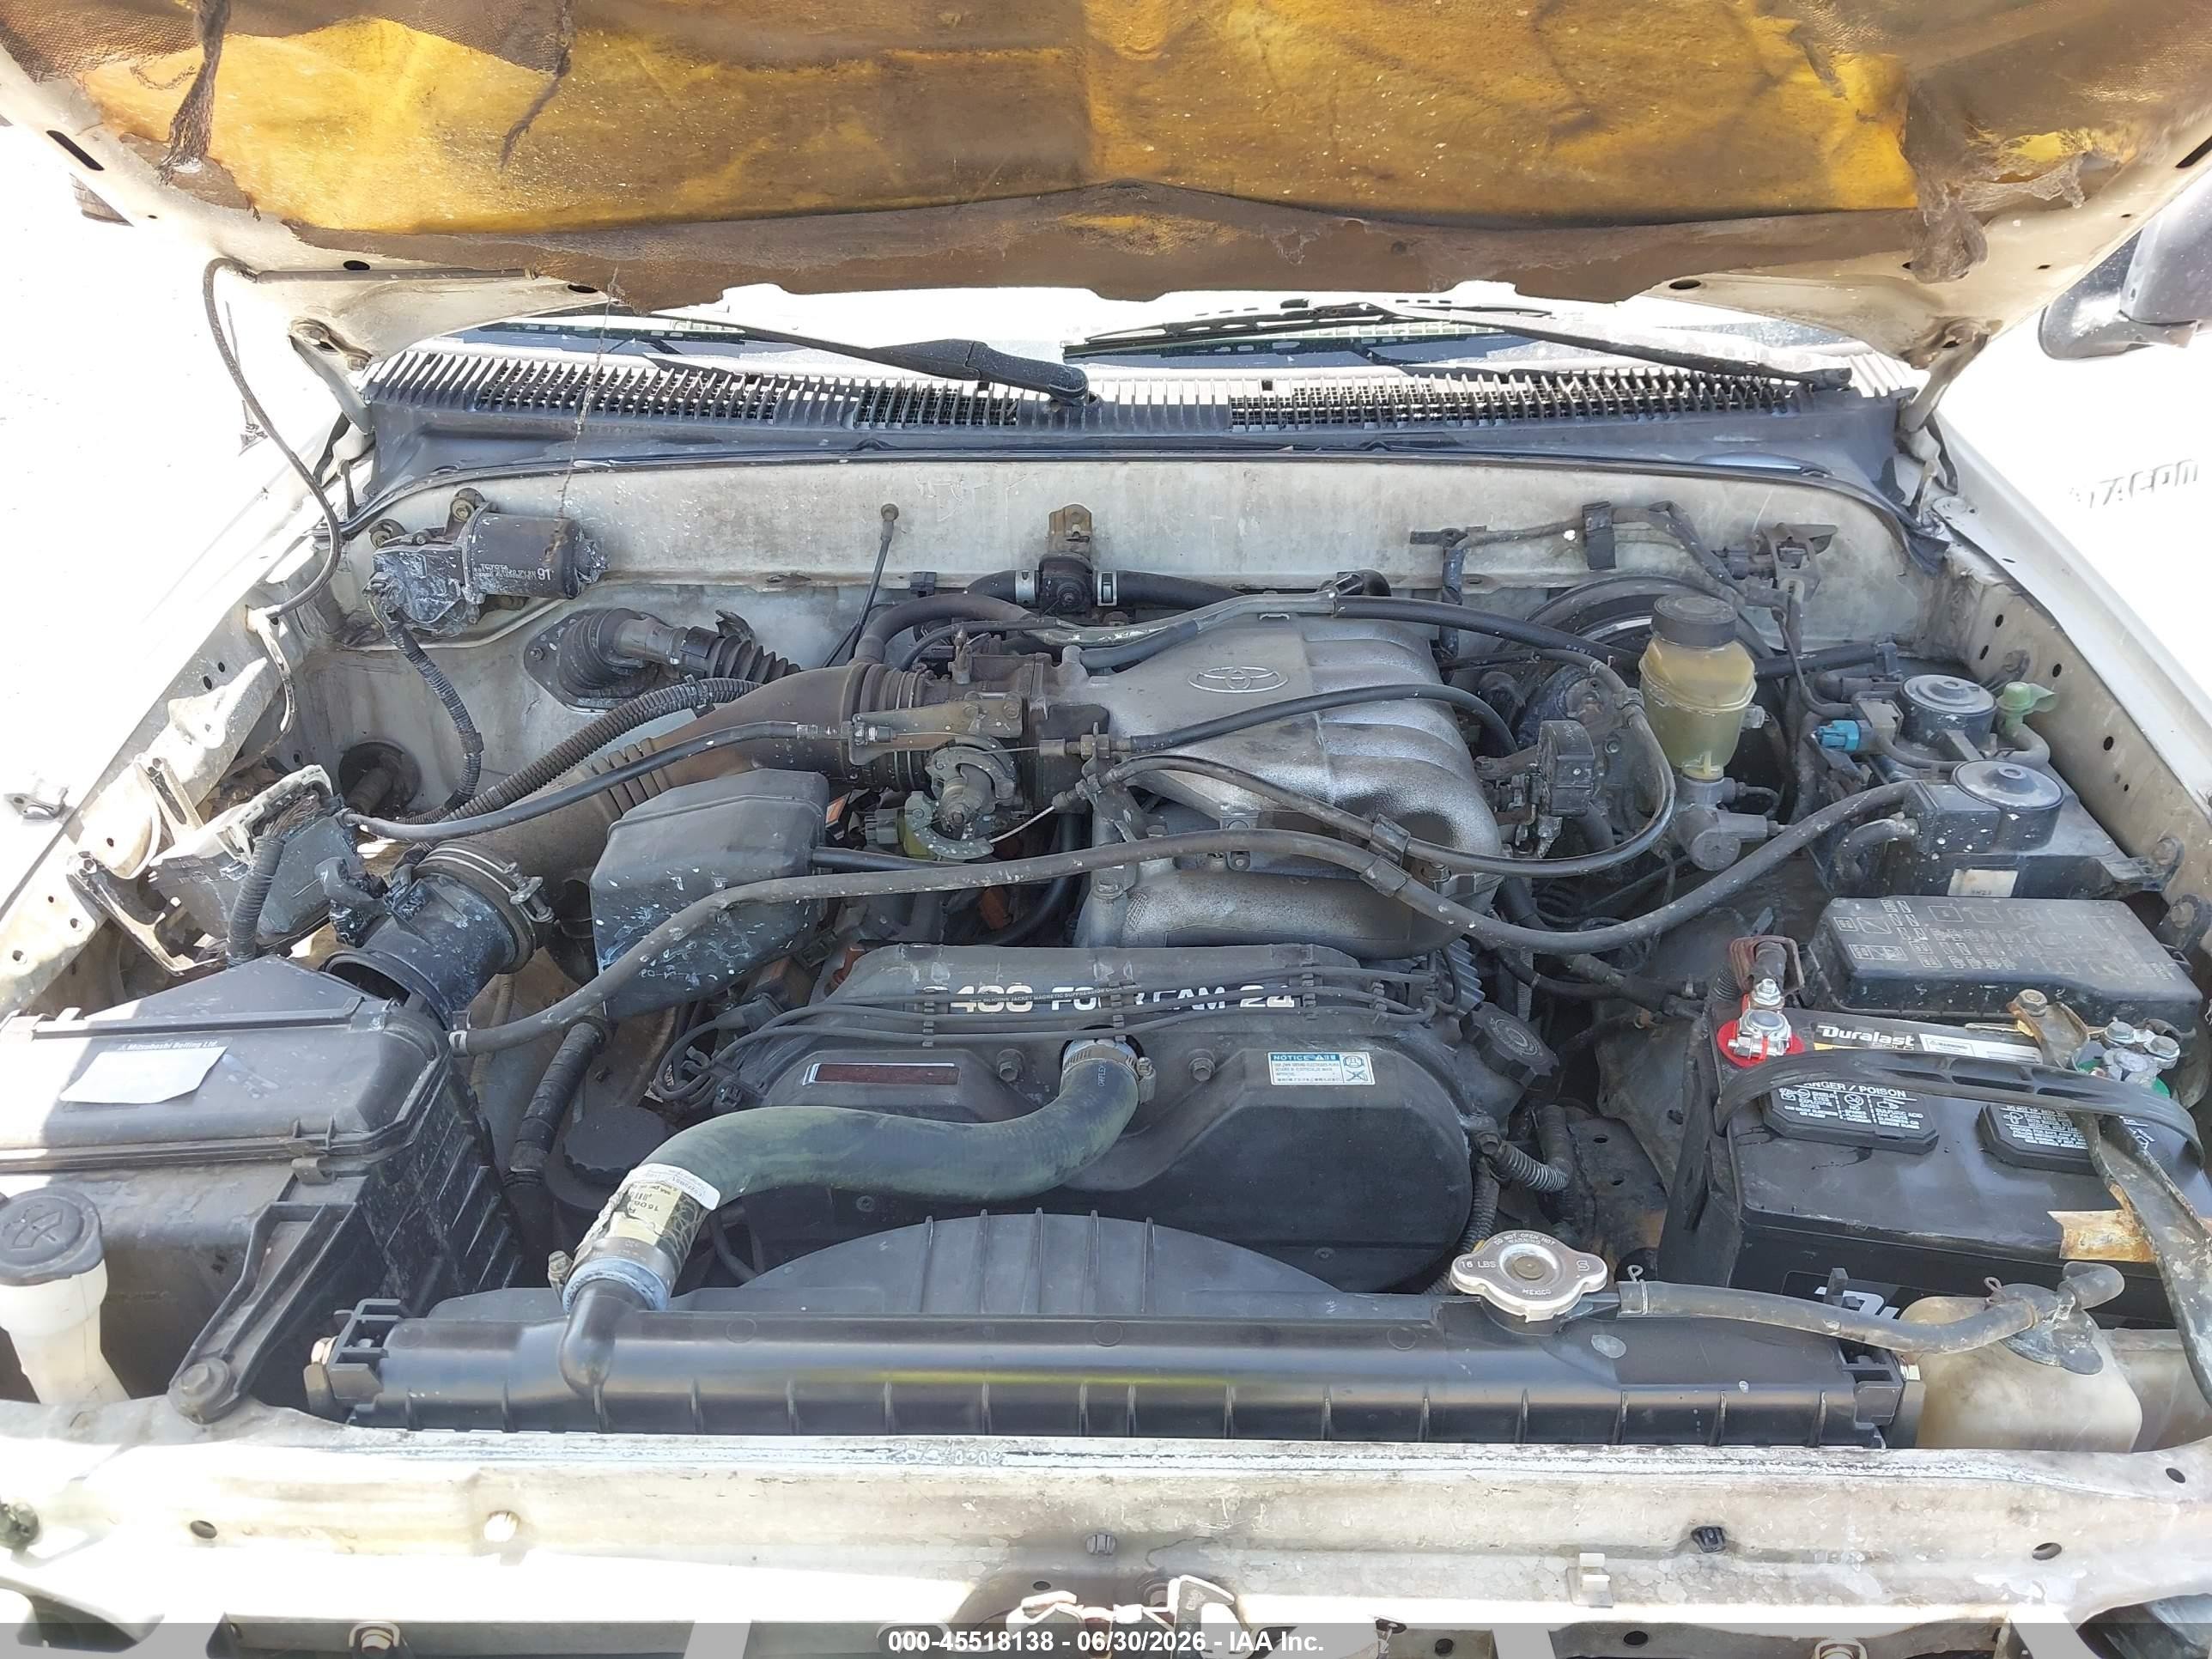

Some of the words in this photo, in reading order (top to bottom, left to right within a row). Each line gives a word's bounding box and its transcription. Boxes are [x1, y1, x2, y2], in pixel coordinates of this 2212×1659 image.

[537, 568, 551, 580] 91
[922, 984, 1033, 1012] 400
[1051, 986, 1146, 1011] FO
[1033, 993, 1064, 1001] MAGNETIC
[1064, 988, 1104, 999] SUPPRESSION
[1818, 1024, 1915, 1048] Duralast
[1803, 1081, 1846, 1091] ANGER
[1858, 1085, 1907, 1098] POISON
[1503, 1232, 1517, 1241] NOT
[1519, 1232, 1540, 1241] OPEN
[1540, 1236, 1556, 1246] HOT
